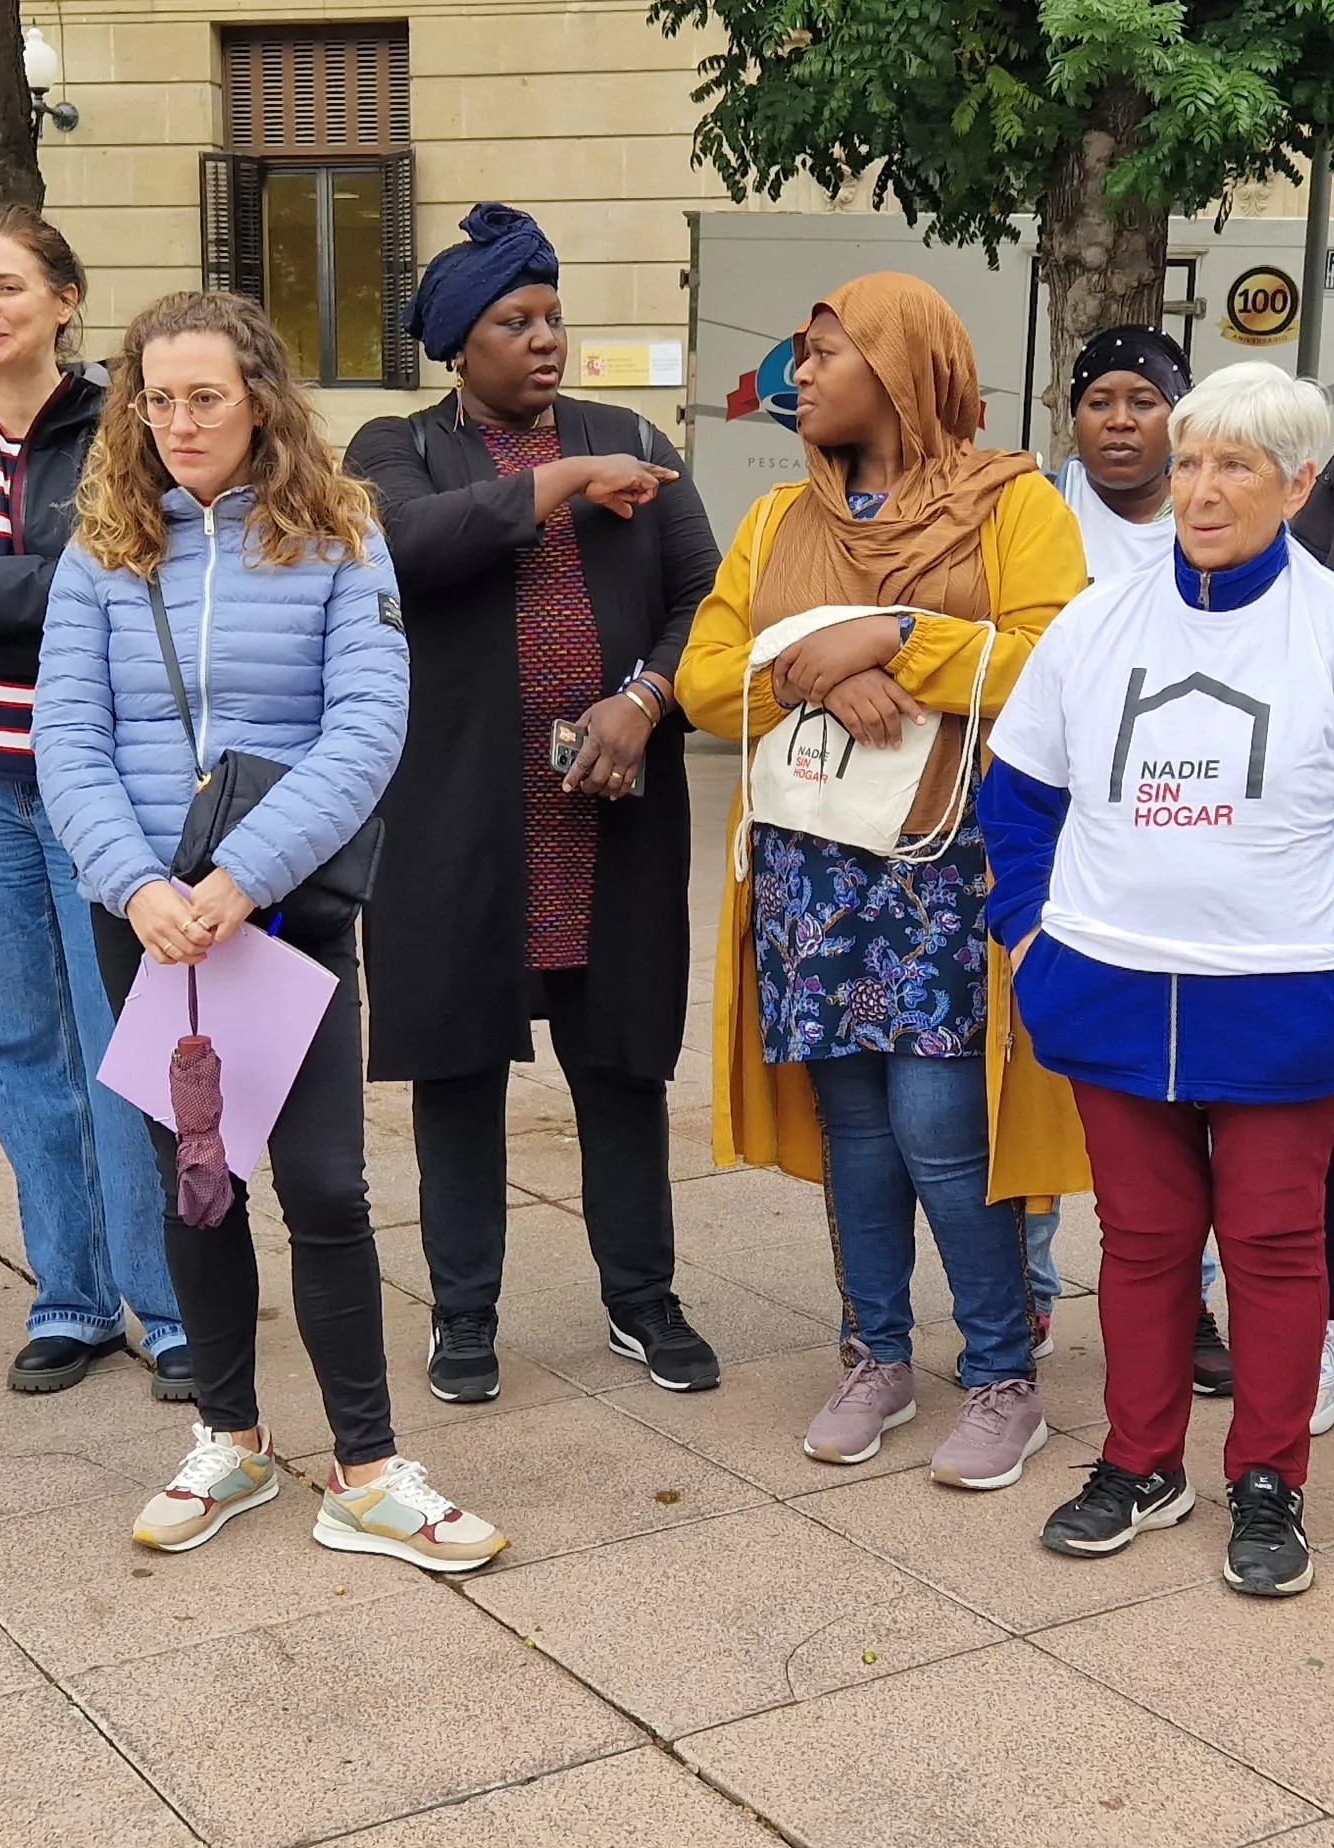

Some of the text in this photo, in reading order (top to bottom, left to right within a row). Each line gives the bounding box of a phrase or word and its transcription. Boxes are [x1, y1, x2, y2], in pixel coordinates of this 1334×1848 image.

[1238, 289, 1288, 314] 100
[1233, 334, 1288, 344] ANIVERSARIO
[795, 756, 811, 768] SIN
[797, 745, 830, 762] NADIE
[793, 768, 829, 784] HOGAR
[1140, 760, 1220, 779] NADIE
[1136, 782, 1181, 803] SIN
[1134, 805, 1234, 827] HOGAR
